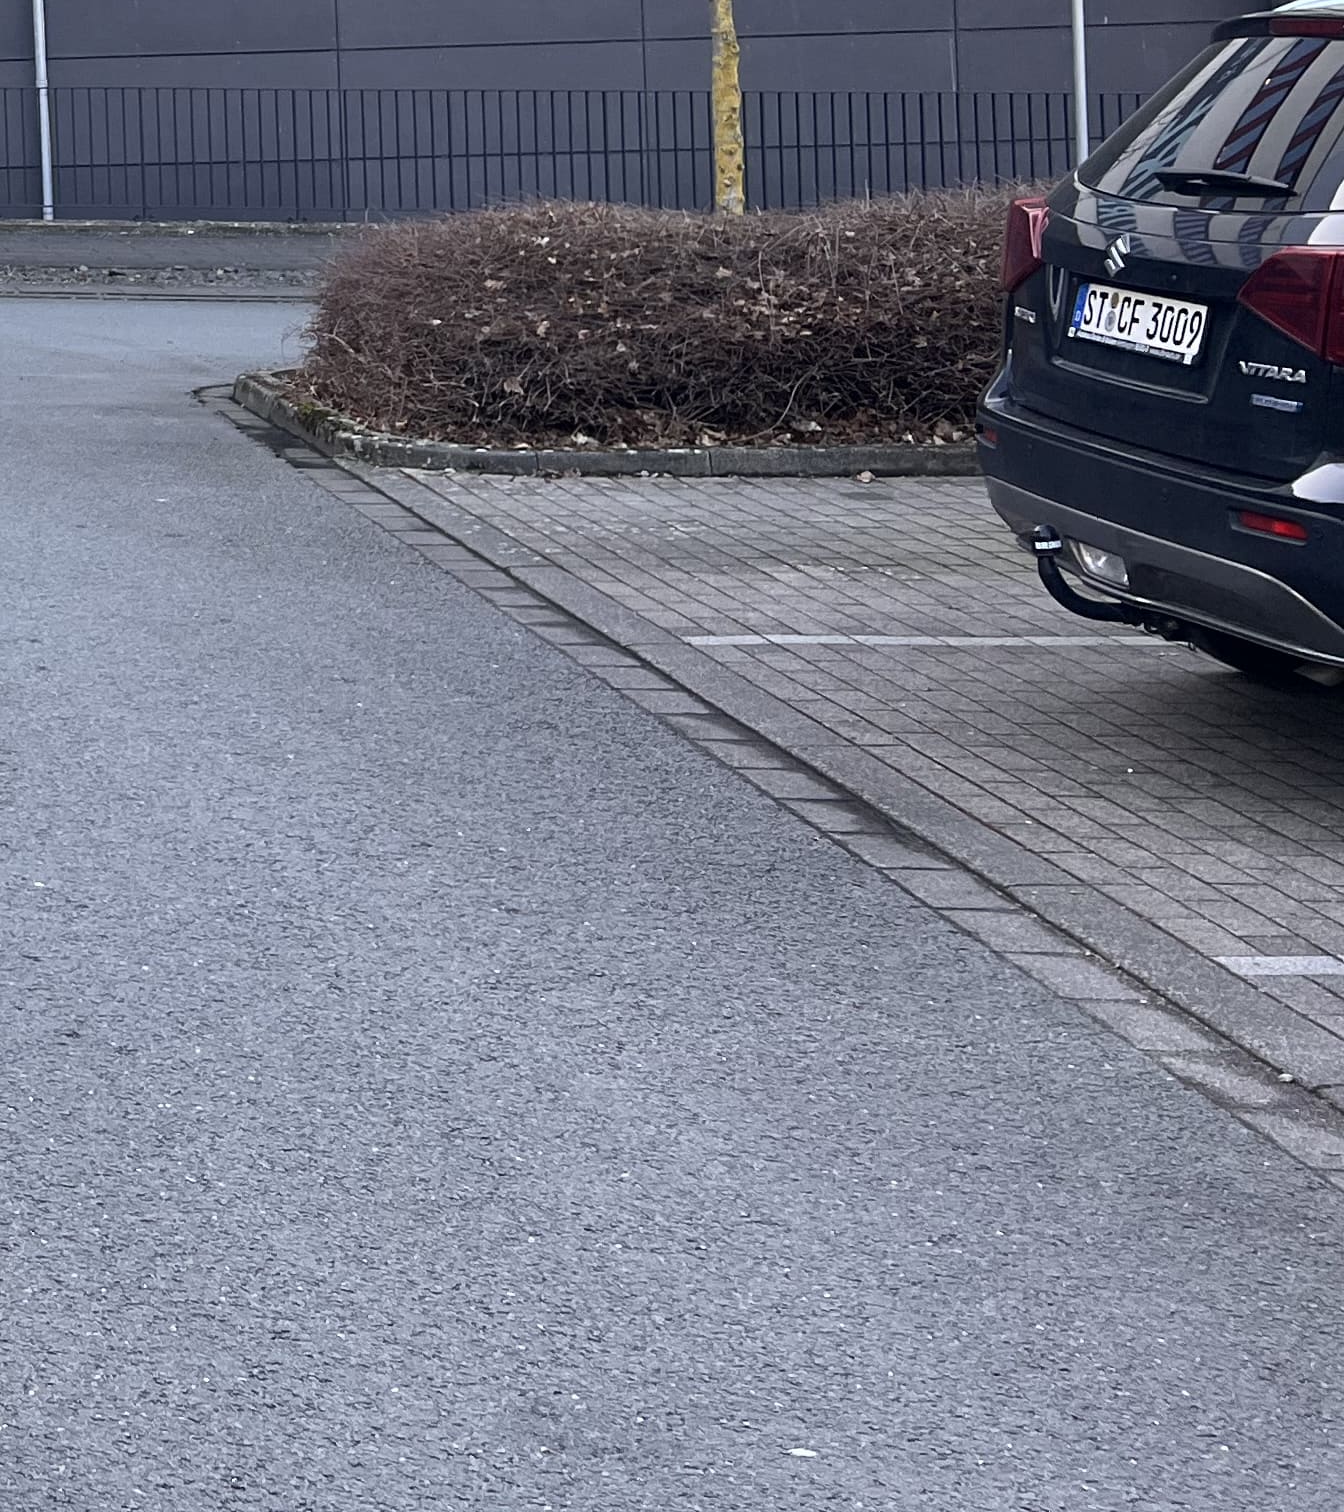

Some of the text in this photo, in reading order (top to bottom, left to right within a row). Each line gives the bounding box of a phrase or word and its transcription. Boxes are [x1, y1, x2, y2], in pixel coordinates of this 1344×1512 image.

[1084, 290, 1109, 329] ST
[1117, 296, 1145, 336] CF
[1146, 302, 1203, 349] 3009
[1238, 360, 1307, 384] VITARA
